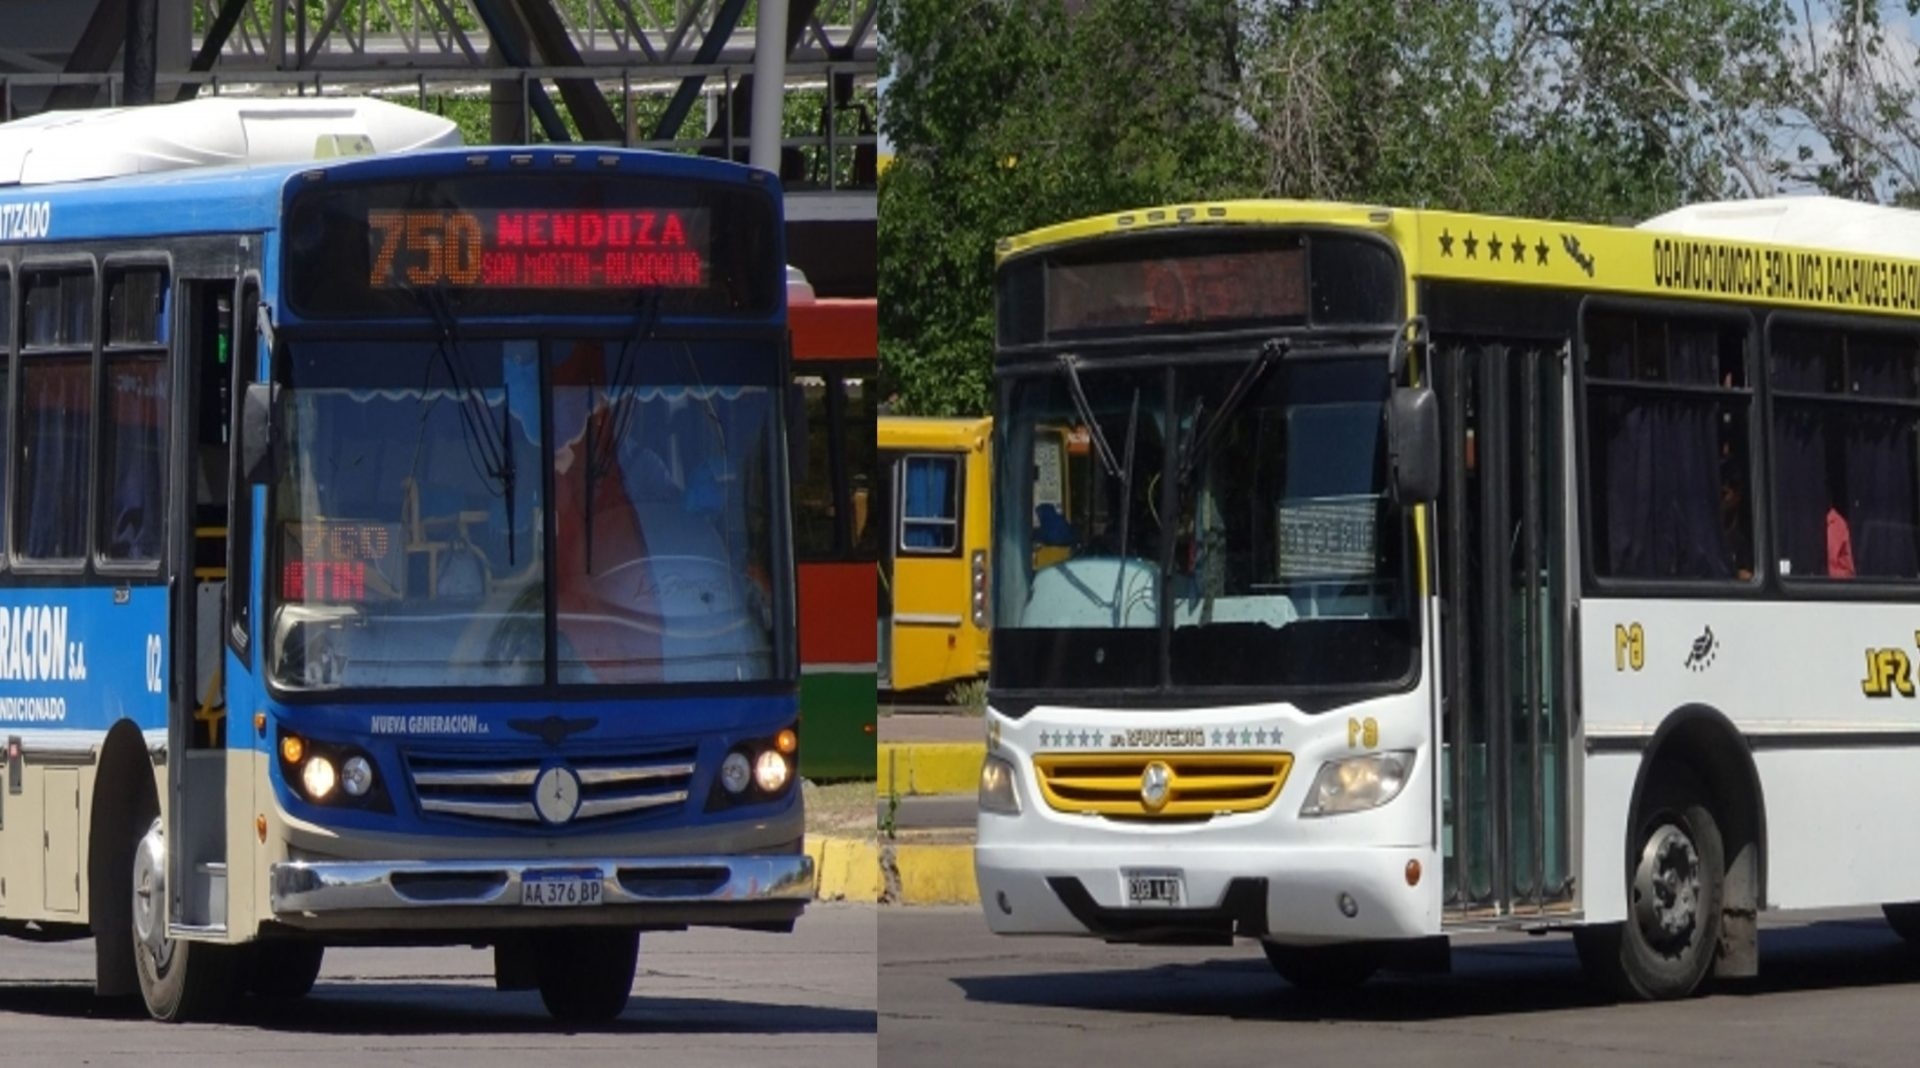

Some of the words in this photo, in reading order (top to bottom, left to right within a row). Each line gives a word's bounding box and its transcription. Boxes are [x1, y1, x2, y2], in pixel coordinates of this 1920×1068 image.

[0, 201, 50, 239] TIZADO
[497, 212, 686, 246] MENDOZA
[368, 213, 482, 285] 750
[483, 252, 517, 285] SAN
[146, 634, 162, 692] 02
[371, 715, 407, 733] NUEVA
[408, 714, 477, 733] GENERACION
[525, 884, 543, 902] AA
[548, 883, 576, 902] 376
[581, 881, 600, 902] BP
